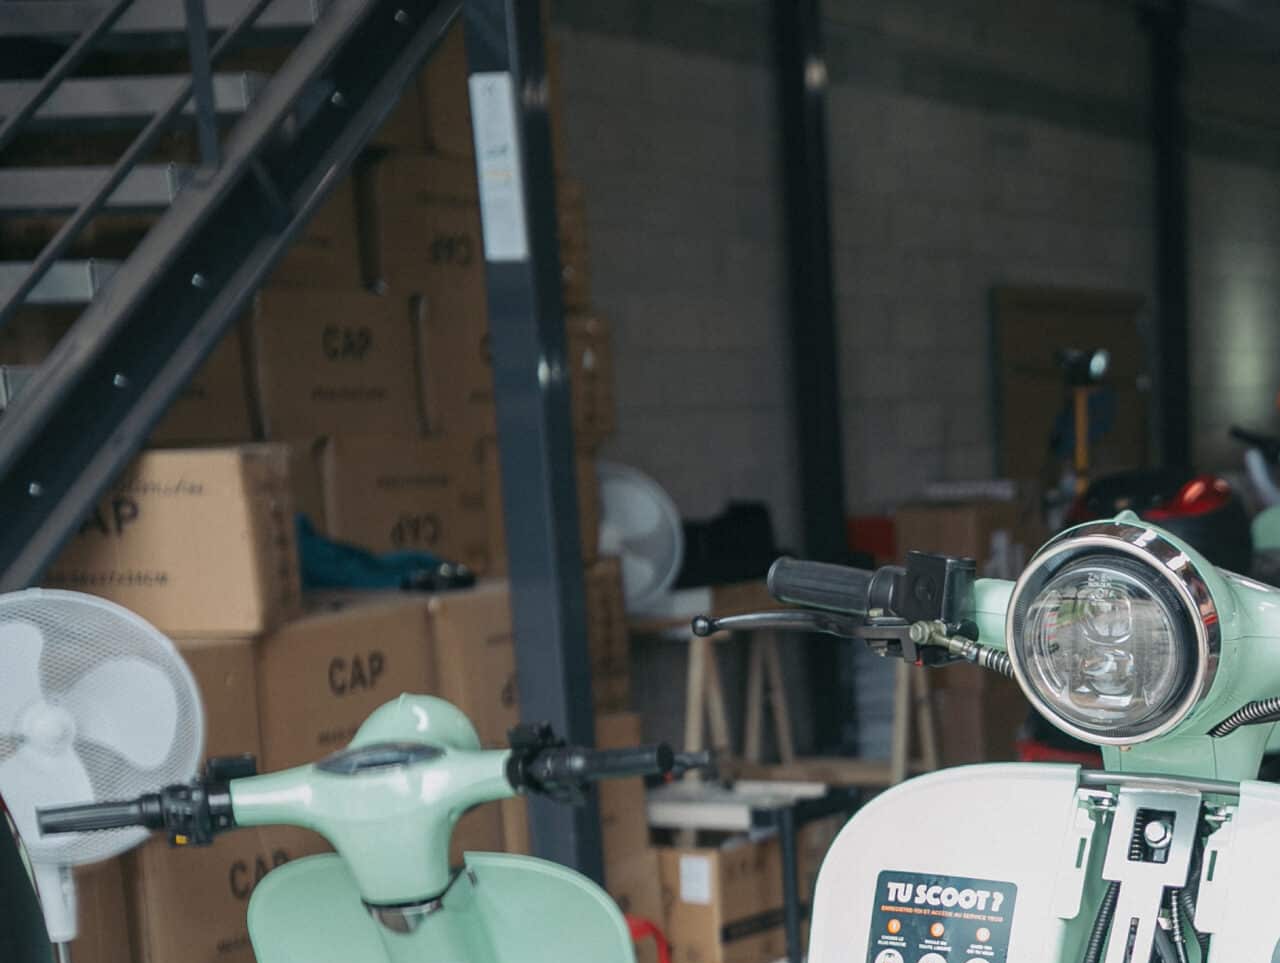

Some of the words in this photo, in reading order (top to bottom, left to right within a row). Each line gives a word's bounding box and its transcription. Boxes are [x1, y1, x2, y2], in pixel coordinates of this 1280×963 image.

[328, 651, 386, 696] CAP
[887, 881, 914, 903] TU
[914, 884, 991, 911] SCOOT
